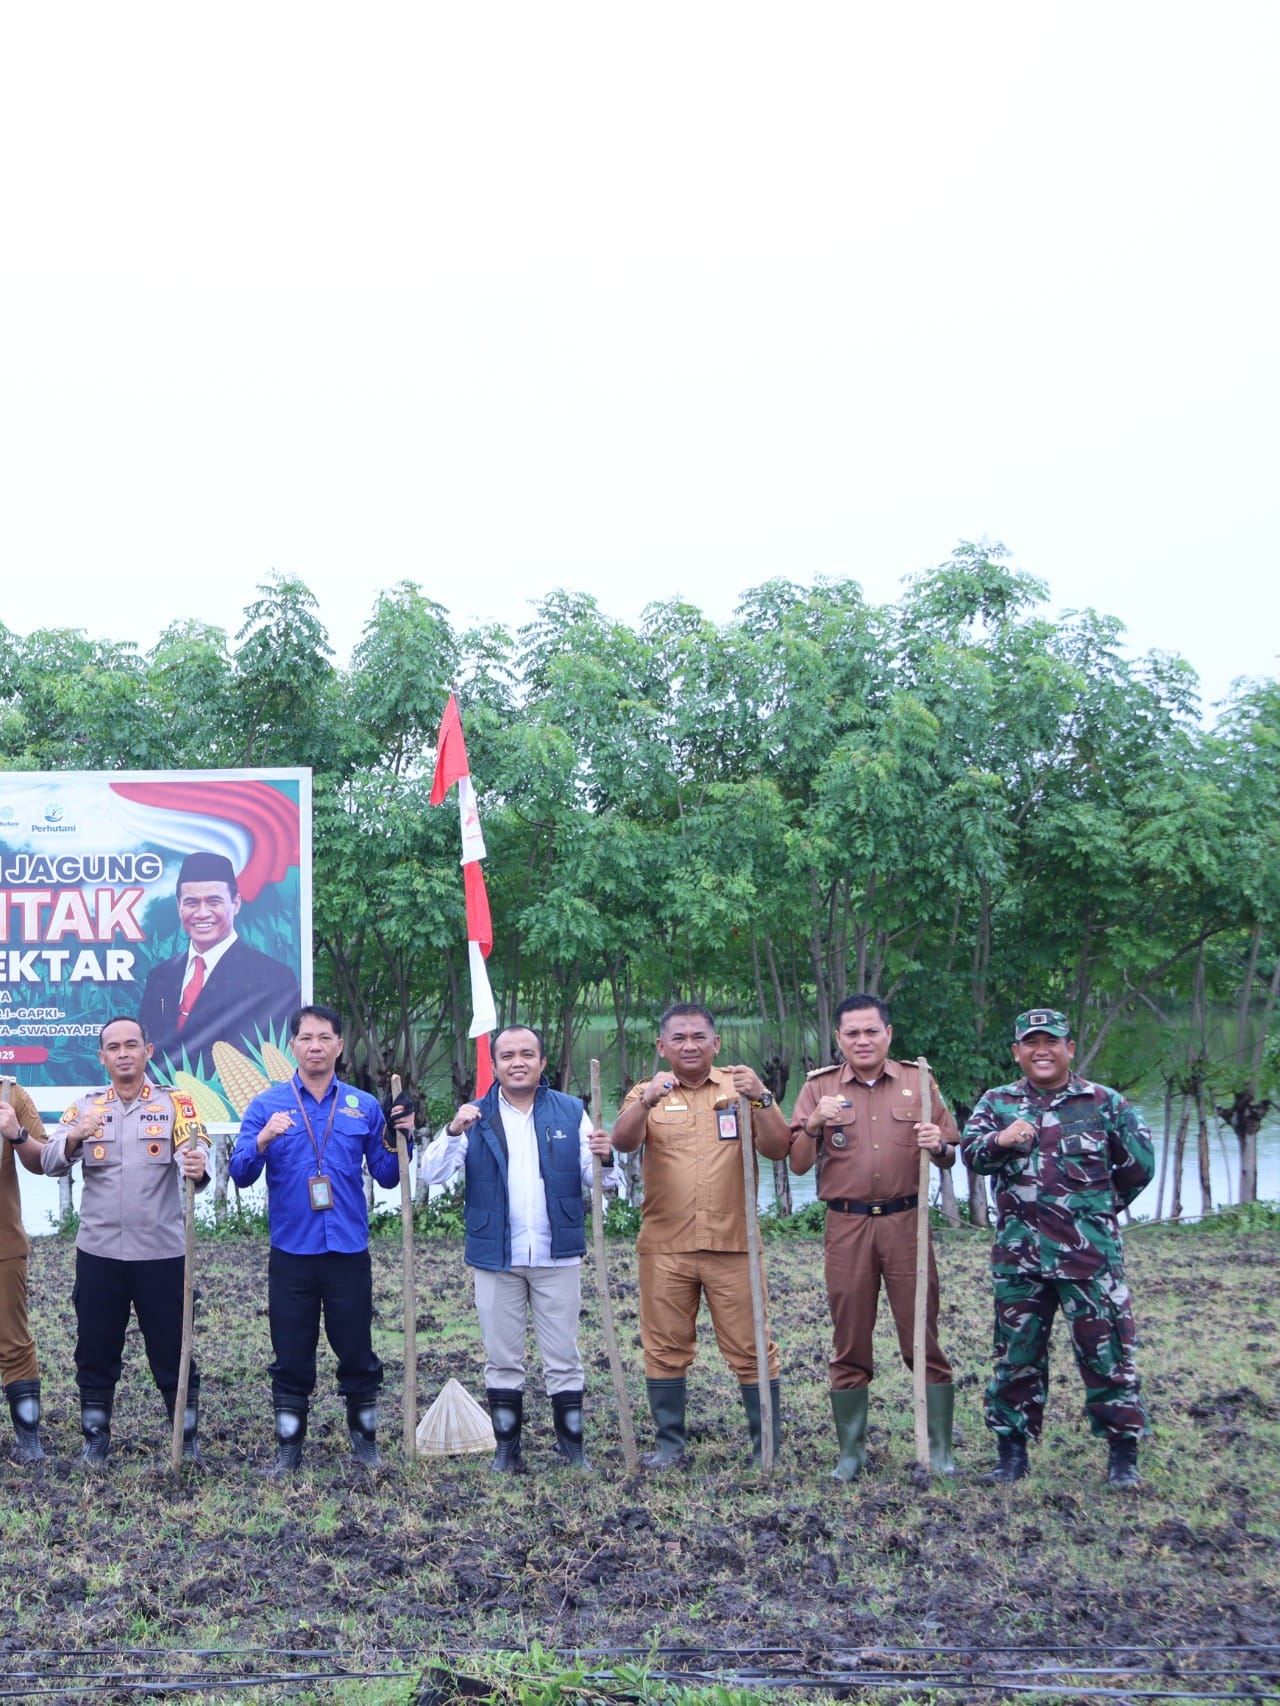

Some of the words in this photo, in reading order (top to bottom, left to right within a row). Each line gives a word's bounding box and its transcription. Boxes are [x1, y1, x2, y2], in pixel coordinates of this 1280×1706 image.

[32, 824, 76, 833] Perhutani
[5, 853, 163, 883] JAGUNG
[17, 1007, 58, 1020] GAPKI
[18, 1025, 82, 1036] SWADAYA
